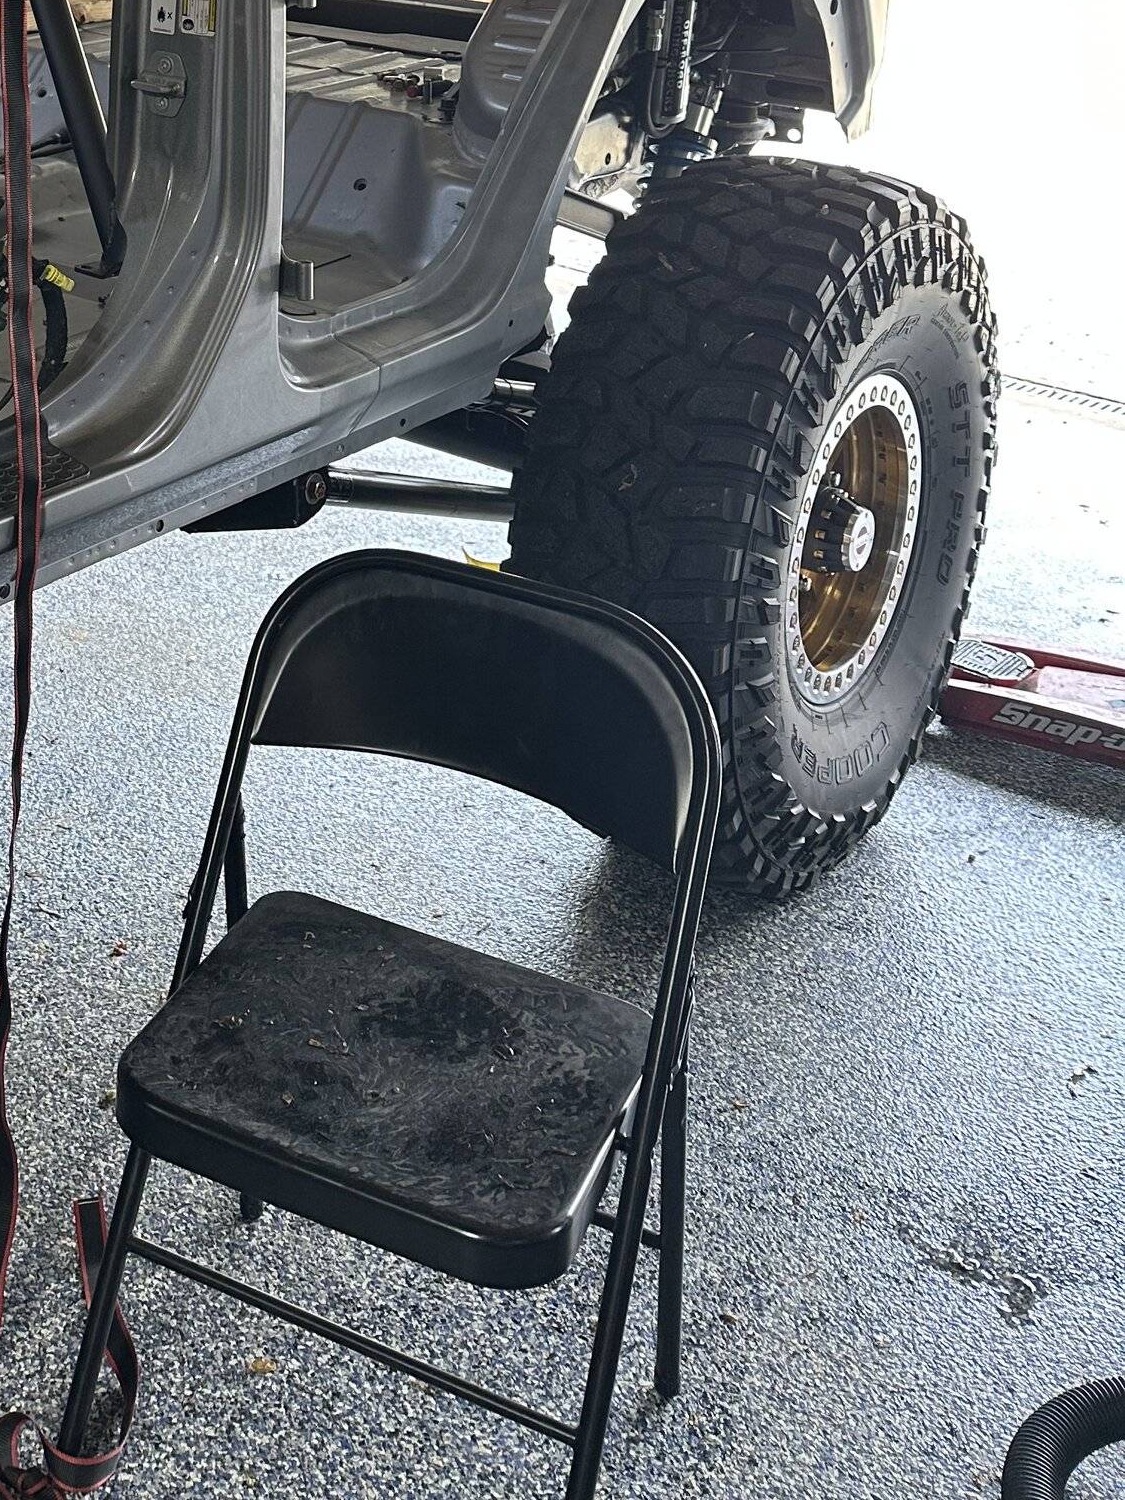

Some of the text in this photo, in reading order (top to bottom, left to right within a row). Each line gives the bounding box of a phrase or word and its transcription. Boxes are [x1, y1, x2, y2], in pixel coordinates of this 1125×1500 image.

[936, 380, 971, 587] STT PRO
[790, 722, 891, 786] COOPER
